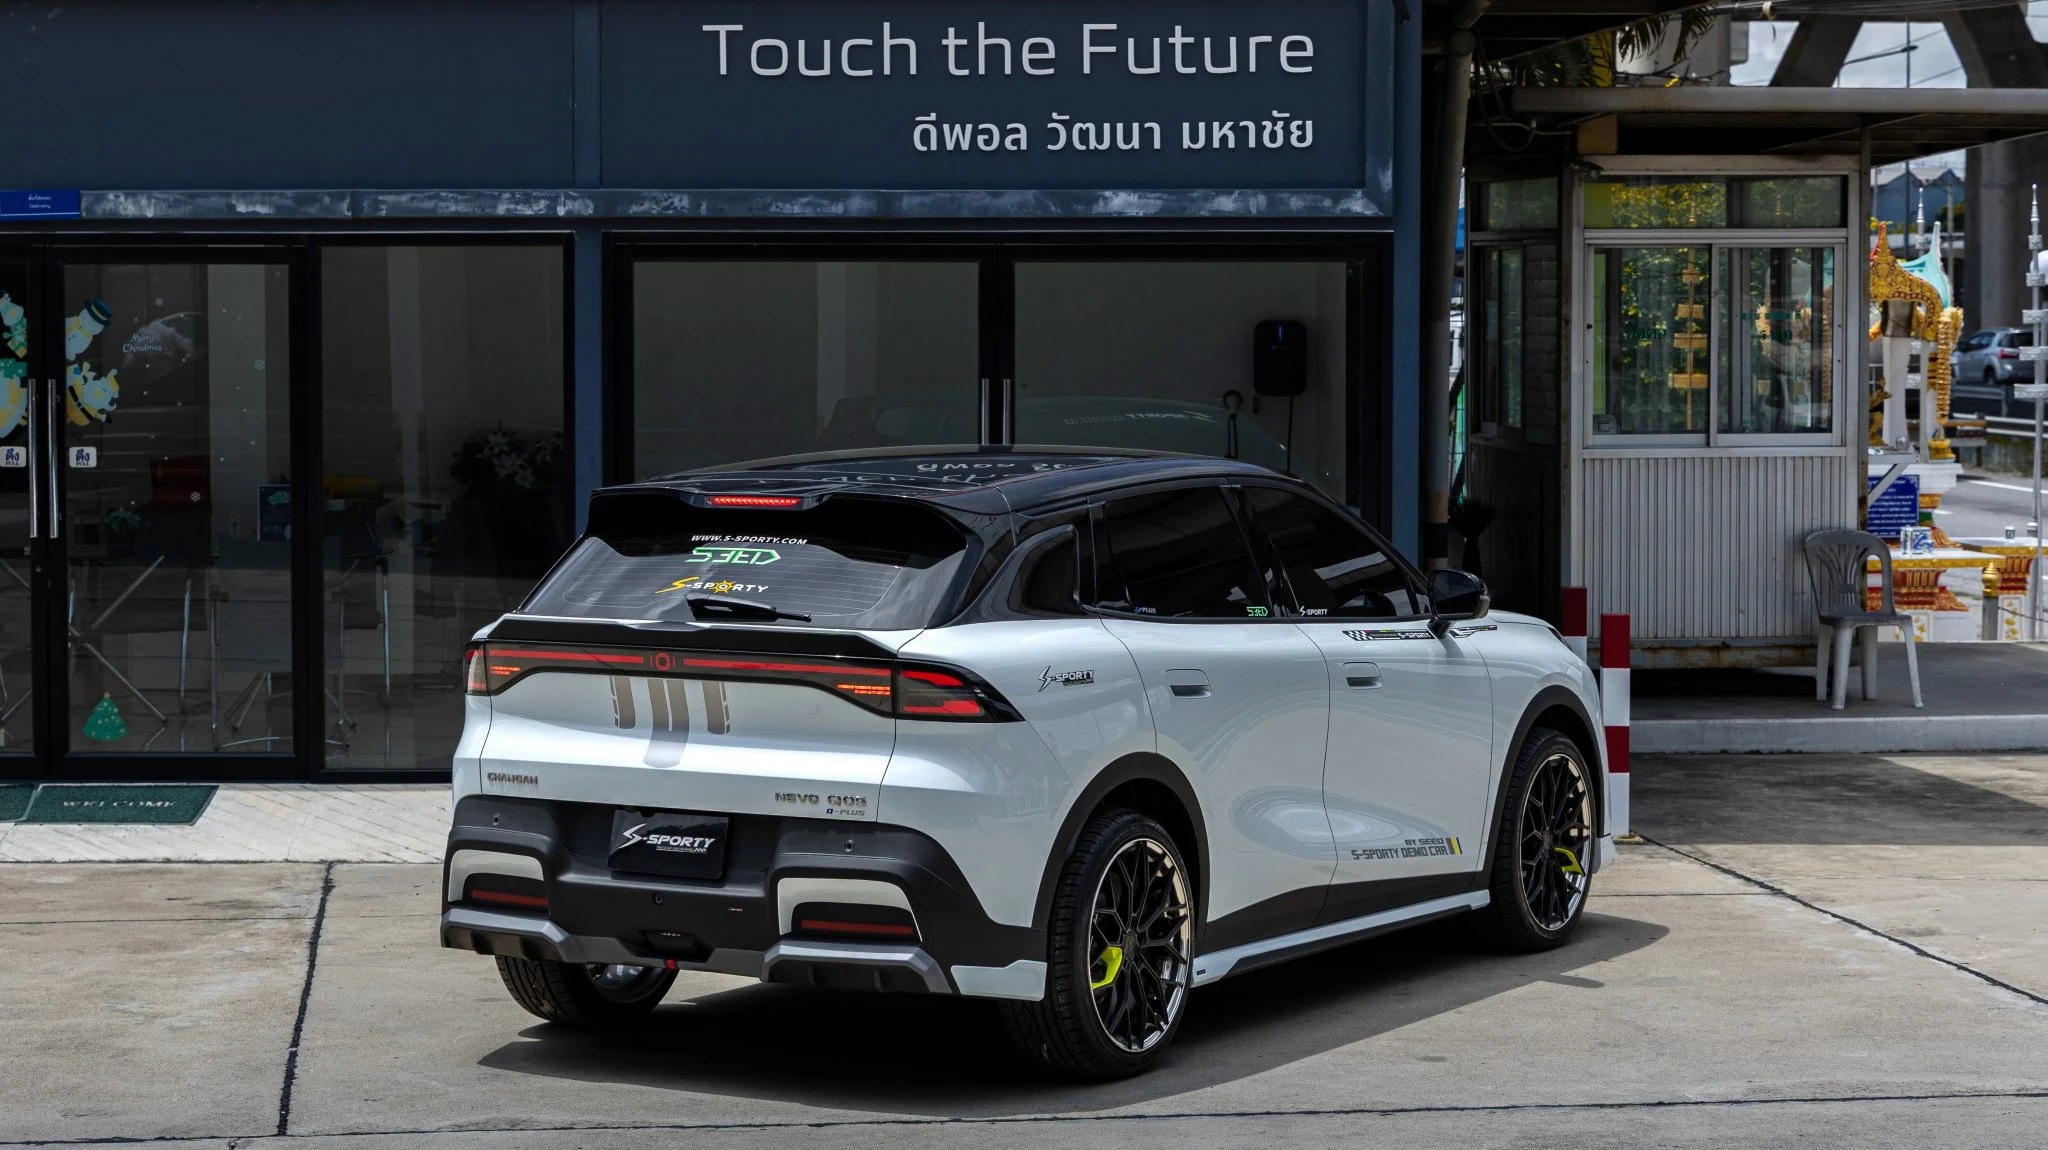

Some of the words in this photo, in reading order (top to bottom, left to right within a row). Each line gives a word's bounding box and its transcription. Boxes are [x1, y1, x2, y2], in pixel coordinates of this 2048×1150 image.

[702, 21, 918, 77] Touch
[941, 22, 1057, 76] the
[1082, 22, 1315, 75] Future
[913, 112, 1029, 151] ดีพอล
[1046, 112, 1162, 151] วัฒนา
[1181, 110, 1315, 150] มหาชัย
[690, 534, 808, 546] WWW.S-SPORTY.COM
[655, 576, 769, 594] S-SPORTY
[1037, 665, 1095, 693] S-SPORTY
[774, 792, 820, 804] NEVO
[617, 822, 716, 849] S-SPORTY
[1419, 837, 1445, 846] SEED
[1351, 847, 1401, 861] S-SPORTY
[1401, 846, 1429, 858] DEMO
[1428, 845, 1449, 856] CAR
